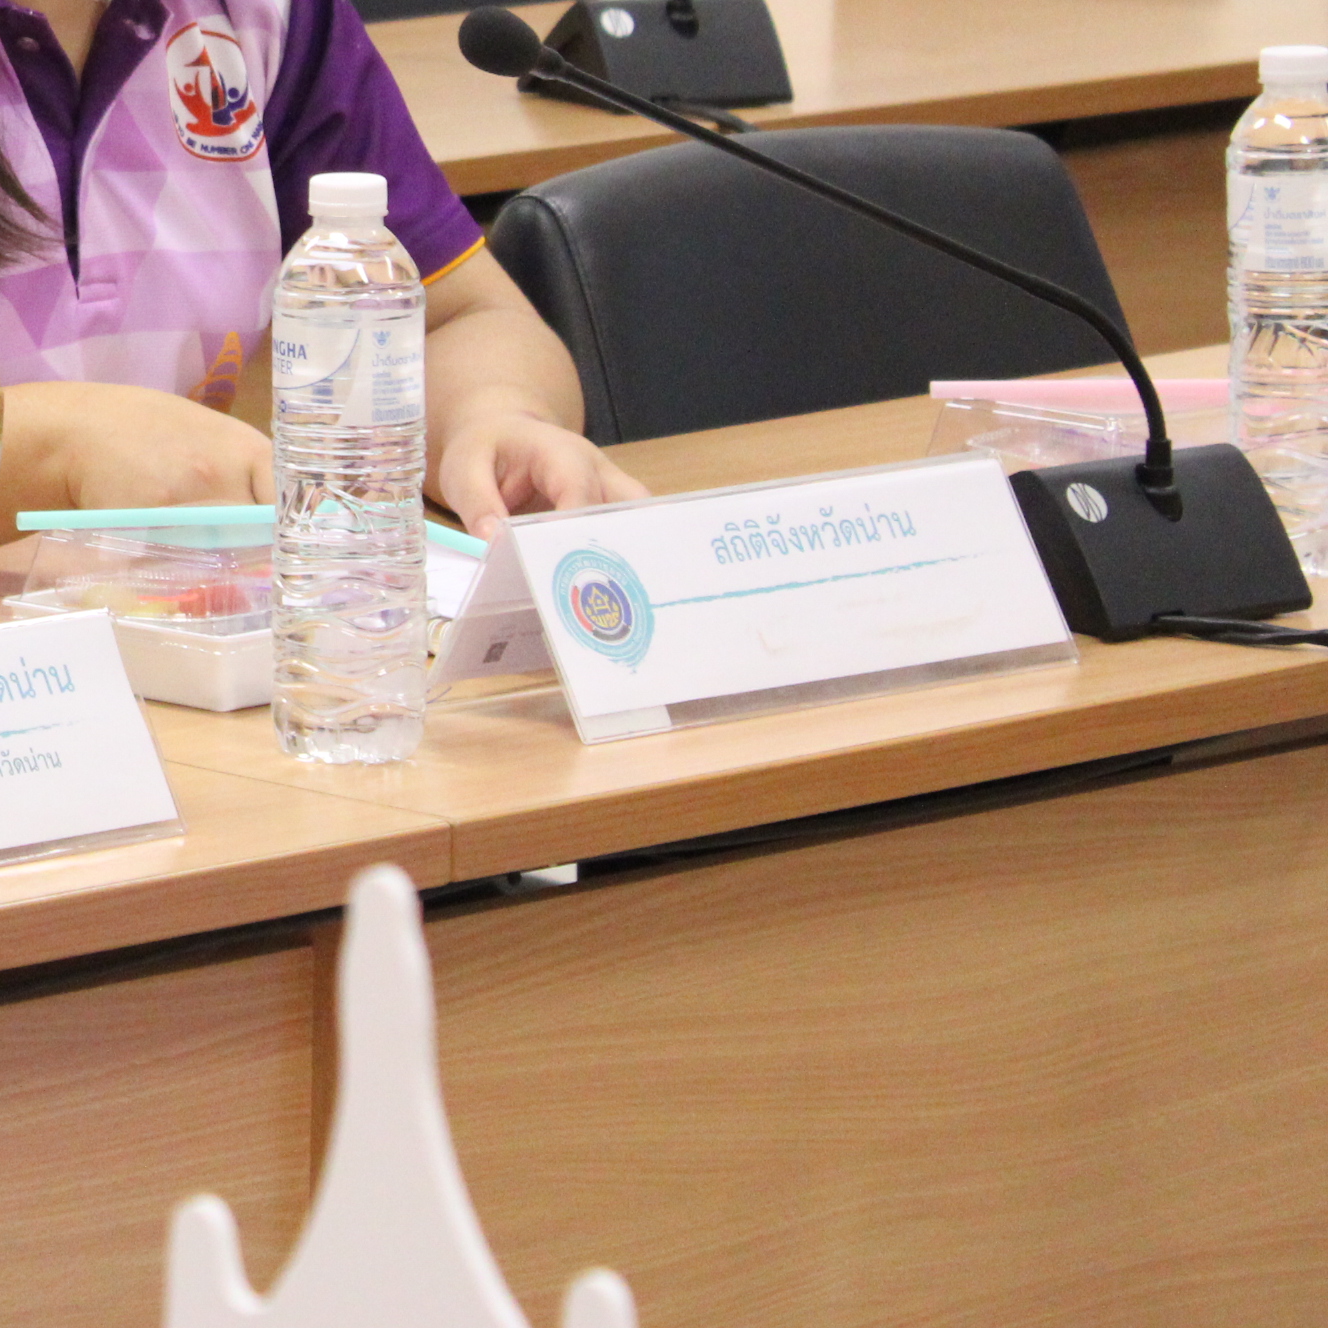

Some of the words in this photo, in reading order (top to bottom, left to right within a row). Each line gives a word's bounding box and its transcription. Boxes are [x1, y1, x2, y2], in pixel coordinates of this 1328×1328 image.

[711, 503, 917, 564] สถิติจังหวัดน่าน
